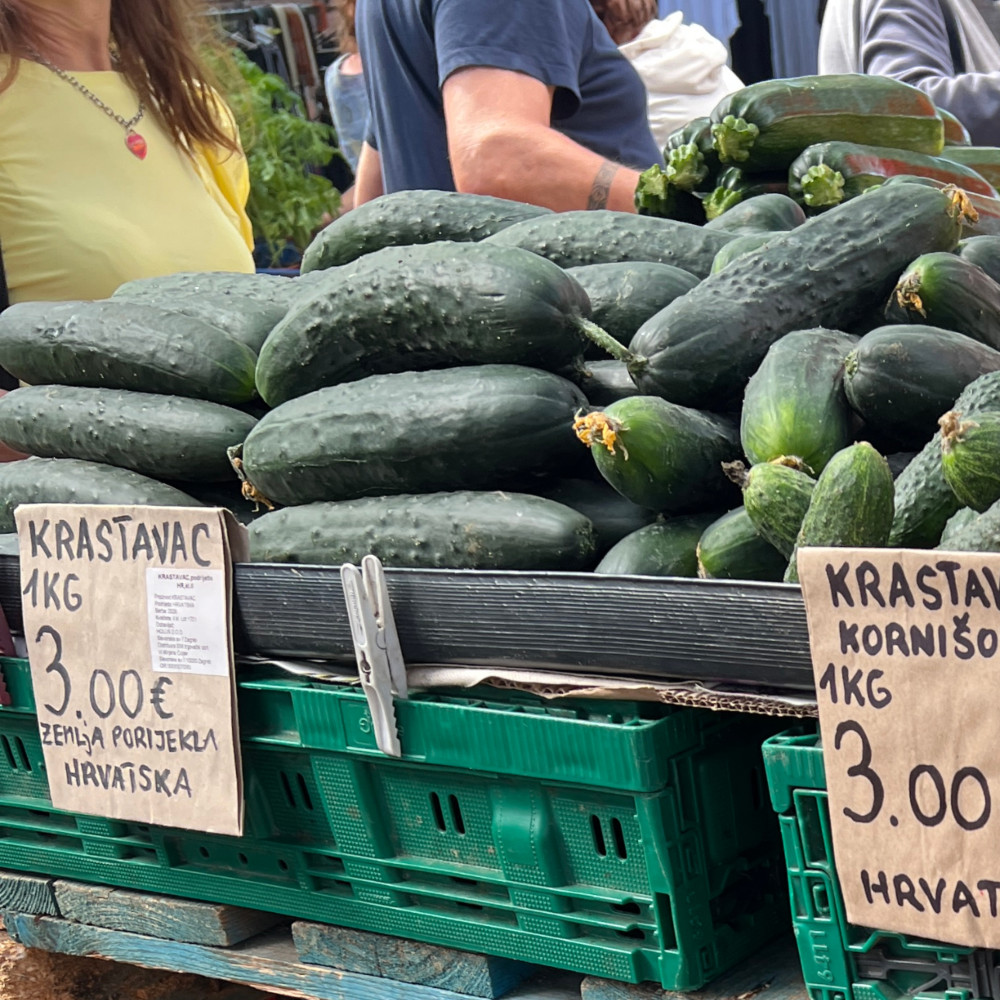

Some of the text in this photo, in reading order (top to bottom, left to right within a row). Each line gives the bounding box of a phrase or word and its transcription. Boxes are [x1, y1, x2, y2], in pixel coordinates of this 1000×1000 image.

[28, 515, 211, 567] KRASTAVAC
[23, 568, 83, 612] 1KG
[819, 663, 892, 709] 1KG
[64, 759, 192, 798] HRVATSKA
[835, 720, 991, 831] 3.00
